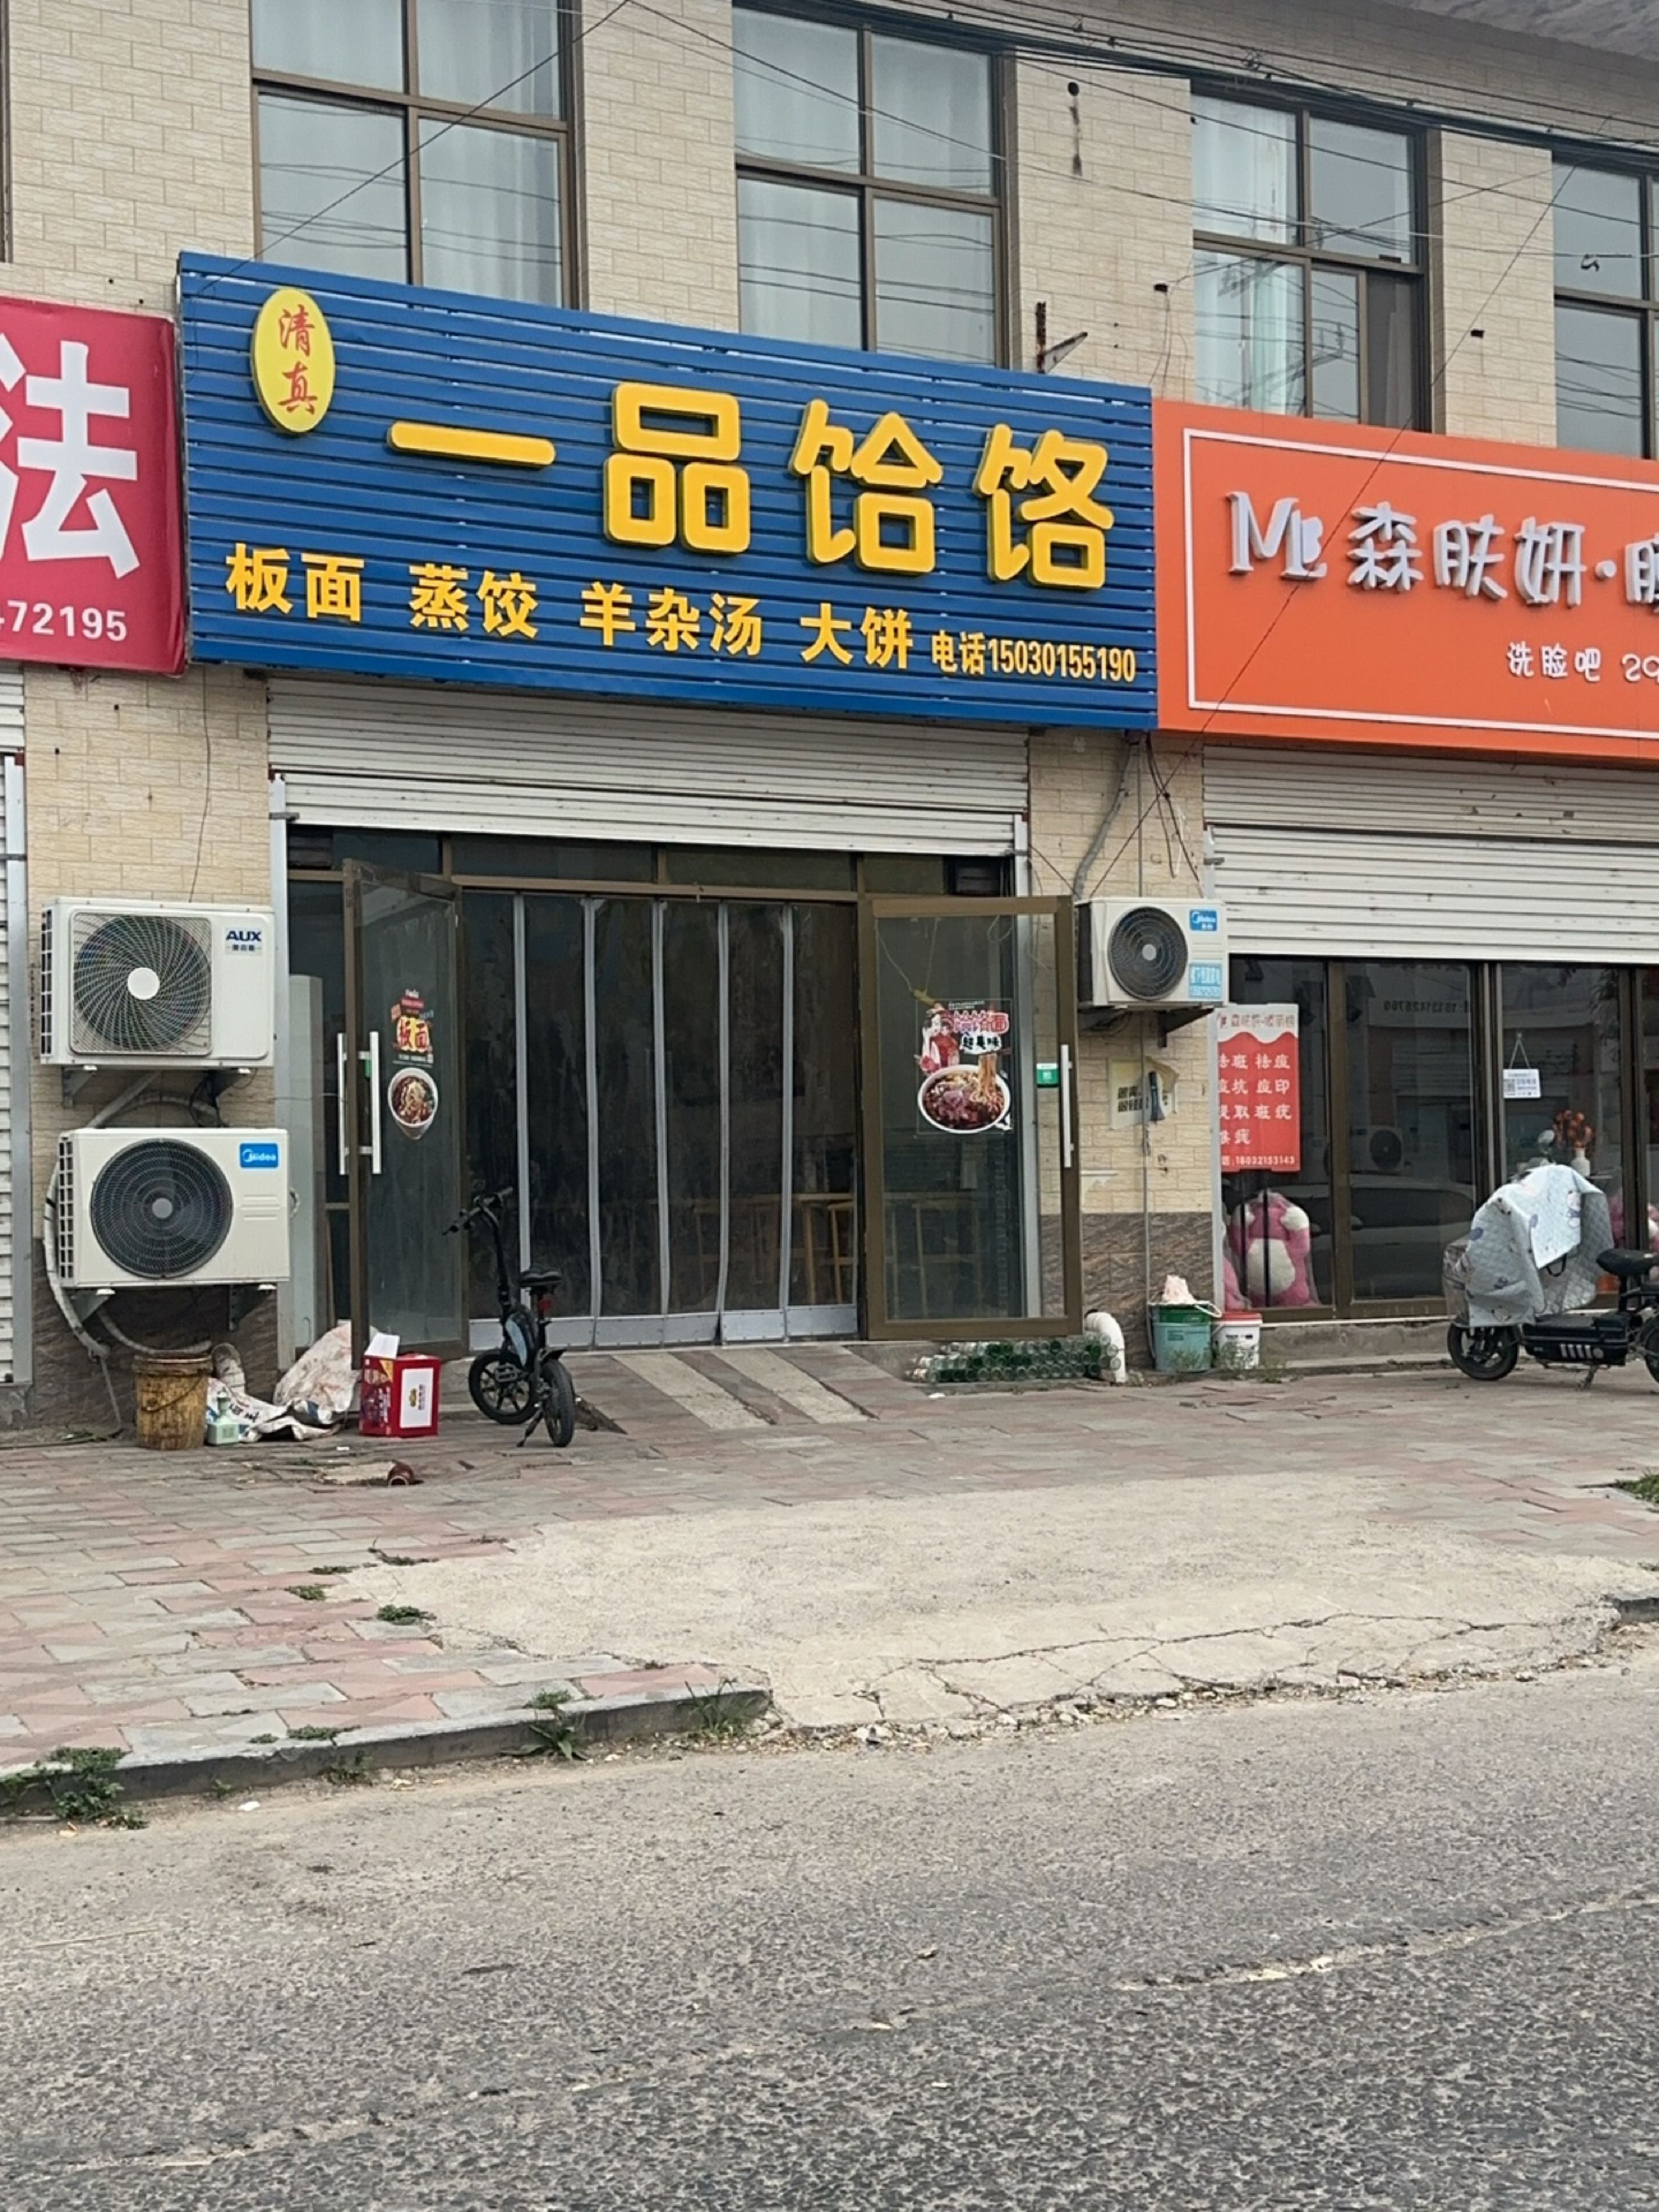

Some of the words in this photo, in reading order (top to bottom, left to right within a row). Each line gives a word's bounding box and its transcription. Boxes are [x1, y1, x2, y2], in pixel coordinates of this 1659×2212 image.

[277, 303, 317, 415] 清真
[0, 332, 140, 579] 法
[387, 381, 1114, 590] 一品饸饹
[0, 599, 127, 641] 72195
[225, 543, 364, 622] 板面
[408, 563, 538, 639] 蒸饺
[579, 582, 762, 656] 羊杂汤
[799, 602, 913, 669] 大饼
[931, 629, 1135, 682] 电话15030155190
[1506, 640, 1601, 683] 洗脸吧
[225, 930, 262, 942] AUX
